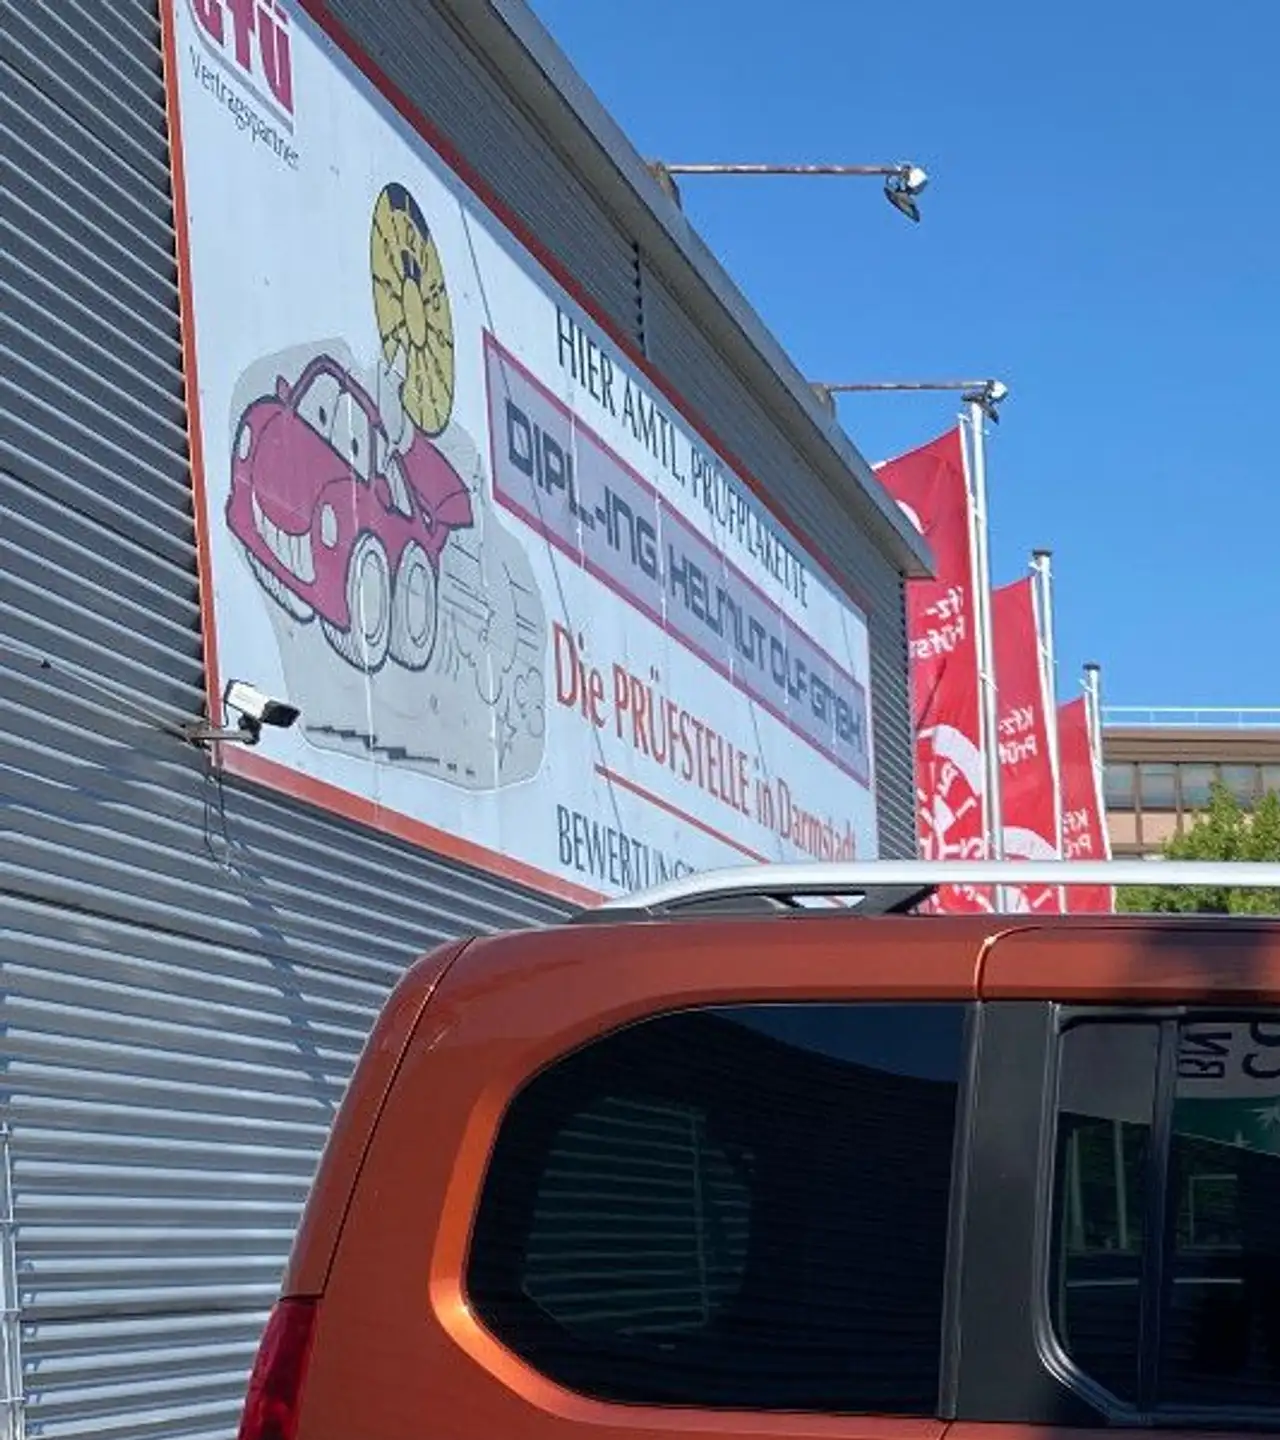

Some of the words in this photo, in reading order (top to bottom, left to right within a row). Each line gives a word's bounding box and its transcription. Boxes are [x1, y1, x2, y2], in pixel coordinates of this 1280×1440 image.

[188, 44, 300, 171] Vertragspartner
[556, 305, 616, 418] HIER
[621, 376, 686, 488] AMTL.
[690, 446, 808, 609] PRÜFPLAKETTE
[668, 543, 767, 672] HELMUT
[552, 620, 606, 729] Die
[612, 662, 750, 817] PRÜFSTELLE
[753, 755, 774, 833] in
[777, 776, 857, 863] Darmstadt
[556, 803, 696, 892] BEWERTUN
